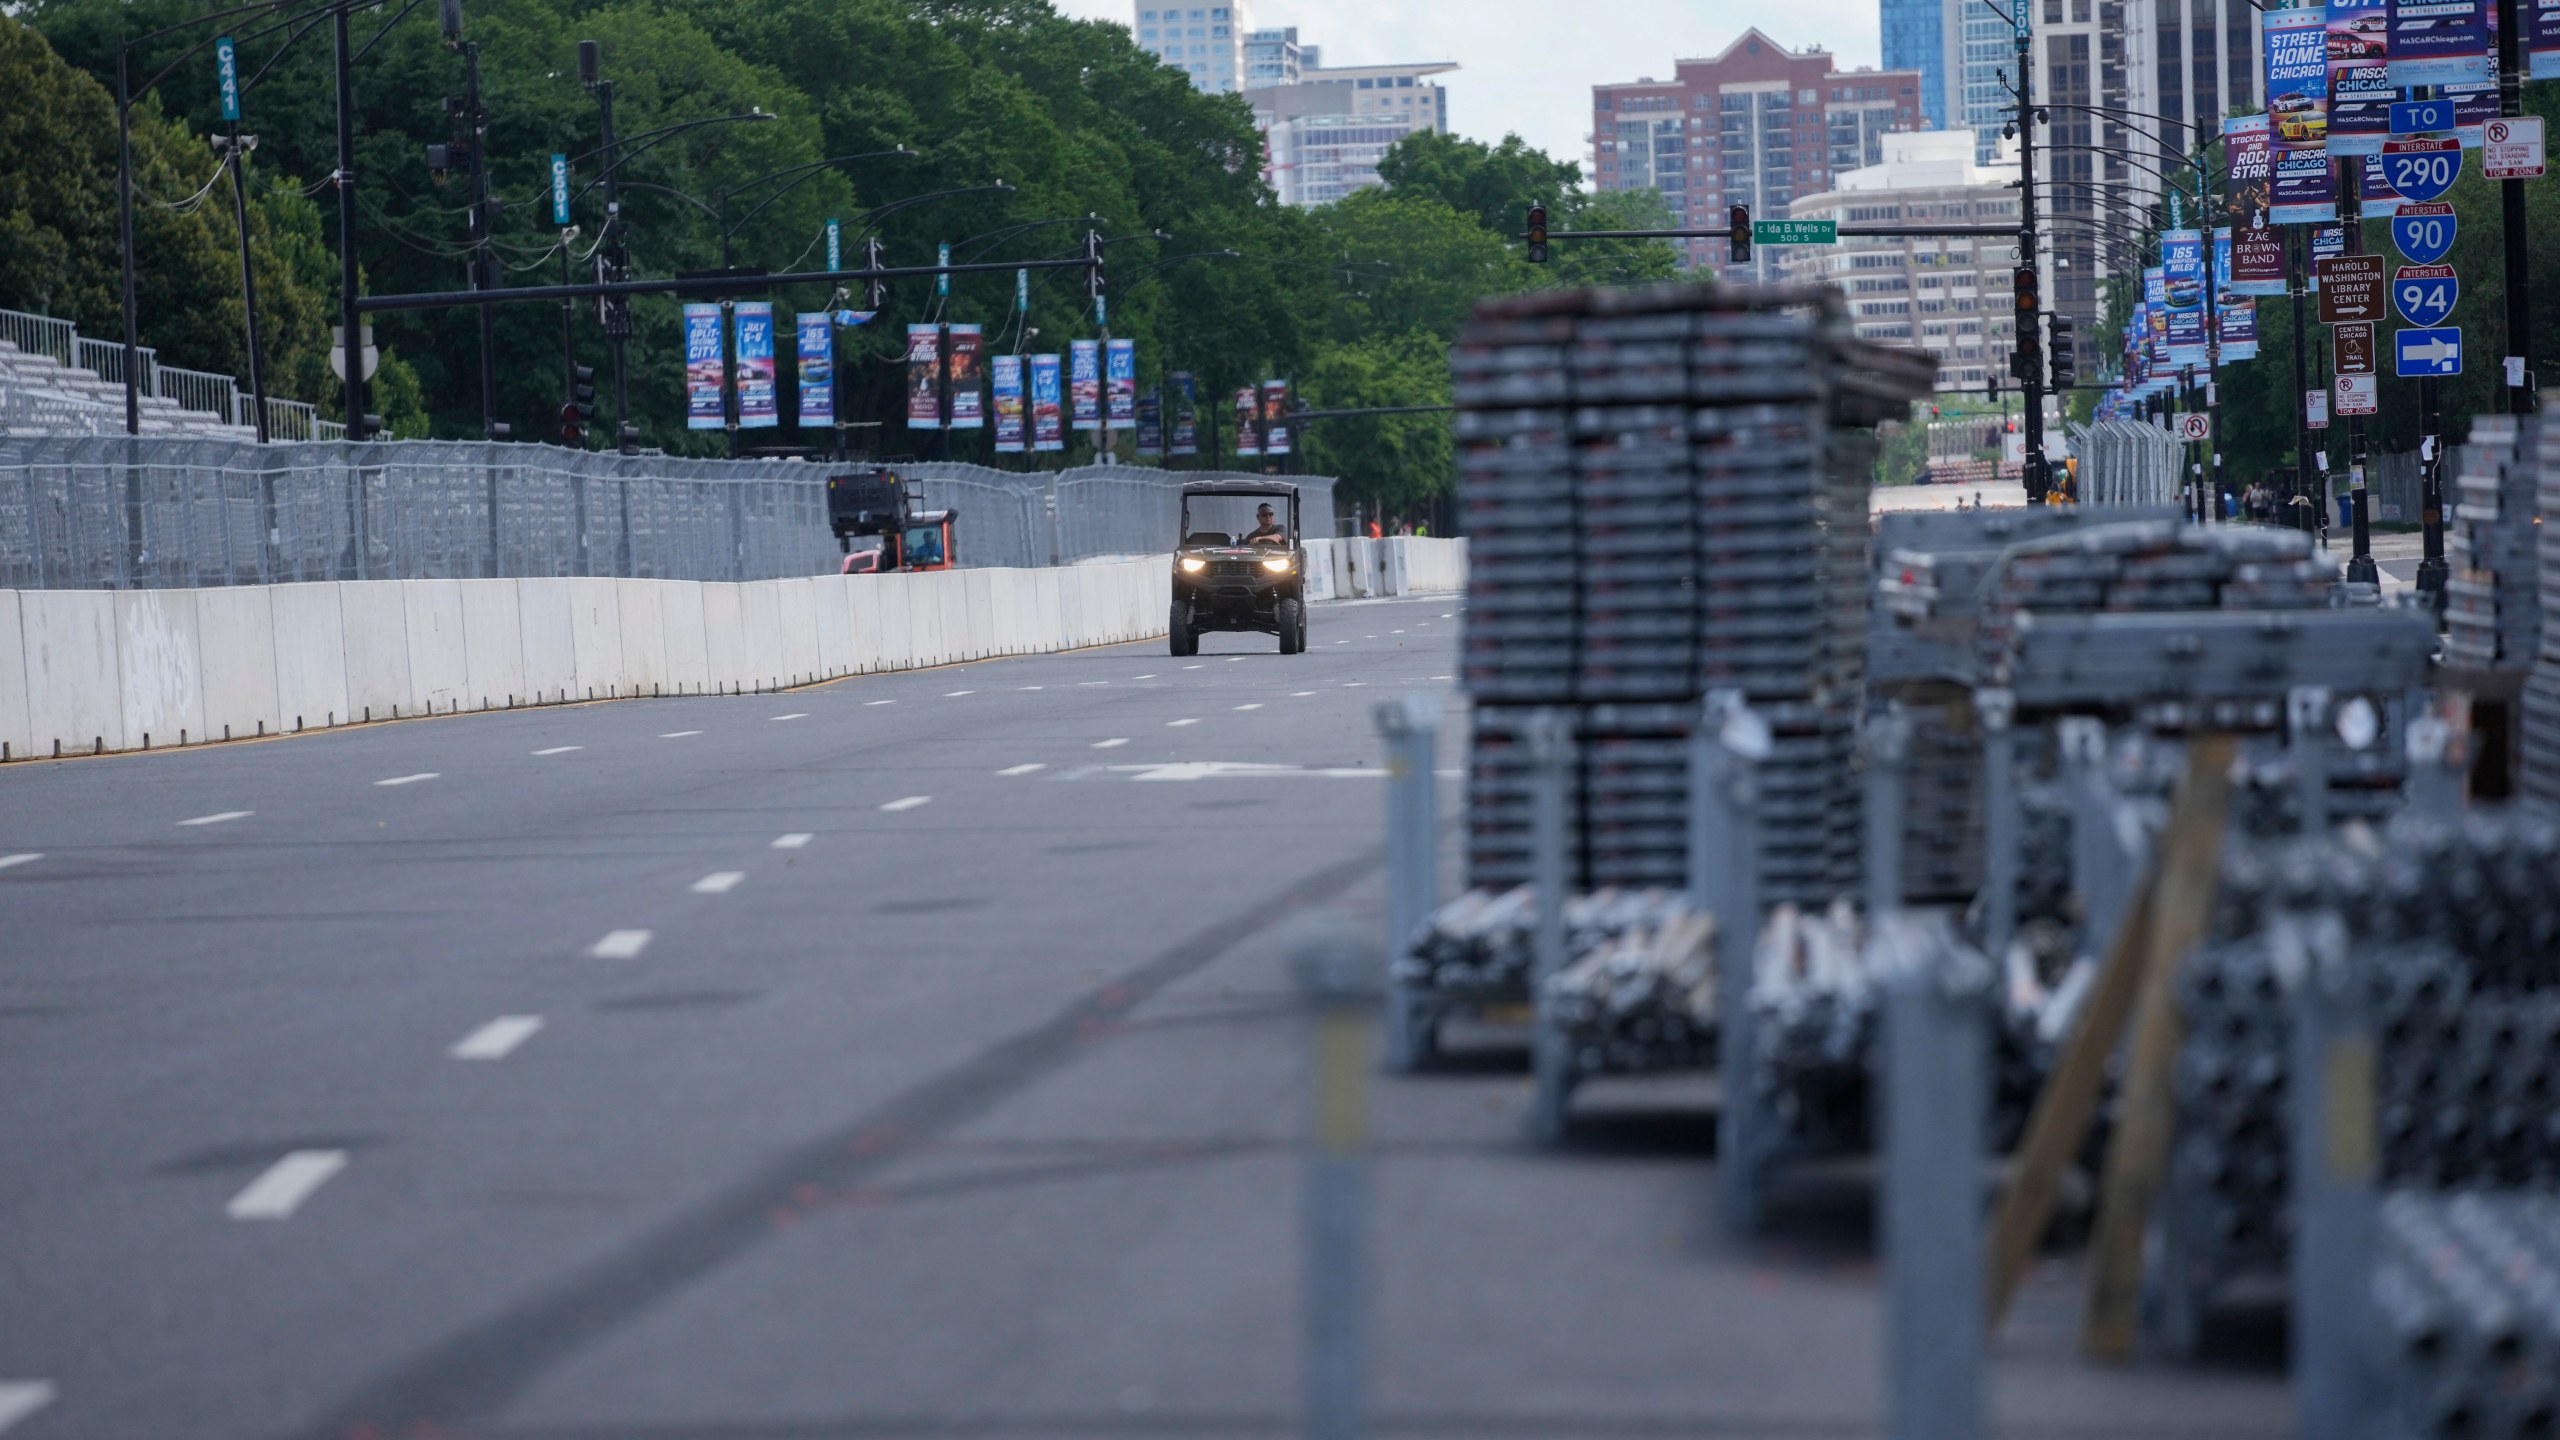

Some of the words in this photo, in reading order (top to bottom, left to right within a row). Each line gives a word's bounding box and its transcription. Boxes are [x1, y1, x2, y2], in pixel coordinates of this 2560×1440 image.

[2271, 31, 2327, 48] STREET
[2400, 35, 2475, 45] NASCARChicago.com
[2351, 43, 2366, 54] 20
[2272, 46, 2326, 66] HOME
[218, 45, 236, 111] C441
[2271, 65, 2325, 80] CHICAGO
[2407, 108, 2437, 126] TO
[2231, 135, 2255, 145] STOCK
[2247, 143, 2263, 151] AND
[2400, 141, 2444, 152] INTERSTATE
[2500, 145, 2529, 153] STOPPING
[2289, 149, 2327, 161] NASCAR
[2500, 152, 2530, 160] STANDING
[2277, 159, 2327, 170] CHICAGO
[2231, 164, 2270, 179] STAR
[2396, 157, 2449, 187] 290
[2489, 168, 2508, 177] TOW
[2513, 166, 2540, 176] ZONE
[553, 161, 566, 218] C501
[2402, 205, 2446, 215] INTERSTATE
[1767, 223, 1781, 233] Ida
[1784, 223, 1793, 233] B.
[1794, 223, 1819, 233] Wells
[1781, 234, 1800, 242] 500
[1803, 234, 1810, 242] S
[2247, 232, 2270, 242] ZAC
[2407, 220, 2442, 249] 90
[2172, 246, 2195, 259] 165
[2236, 243, 2280, 254] BROWN
[2242, 254, 2275, 264] BAND
[2170, 263, 2195, 272] MILES
[2331, 261, 2370, 272] HAROLD
[2321, 272, 2381, 283] WASHINGTON
[2403, 269, 2448, 278] INTERSTATE
[2331, 283, 2371, 294] LIBRARY
[2333, 294, 2370, 304] CENTER
[2403, 285, 2447, 314] 94
[744, 322, 767, 332] JULY
[806, 328, 825, 338] 165
[689, 345, 719, 359] CITY
